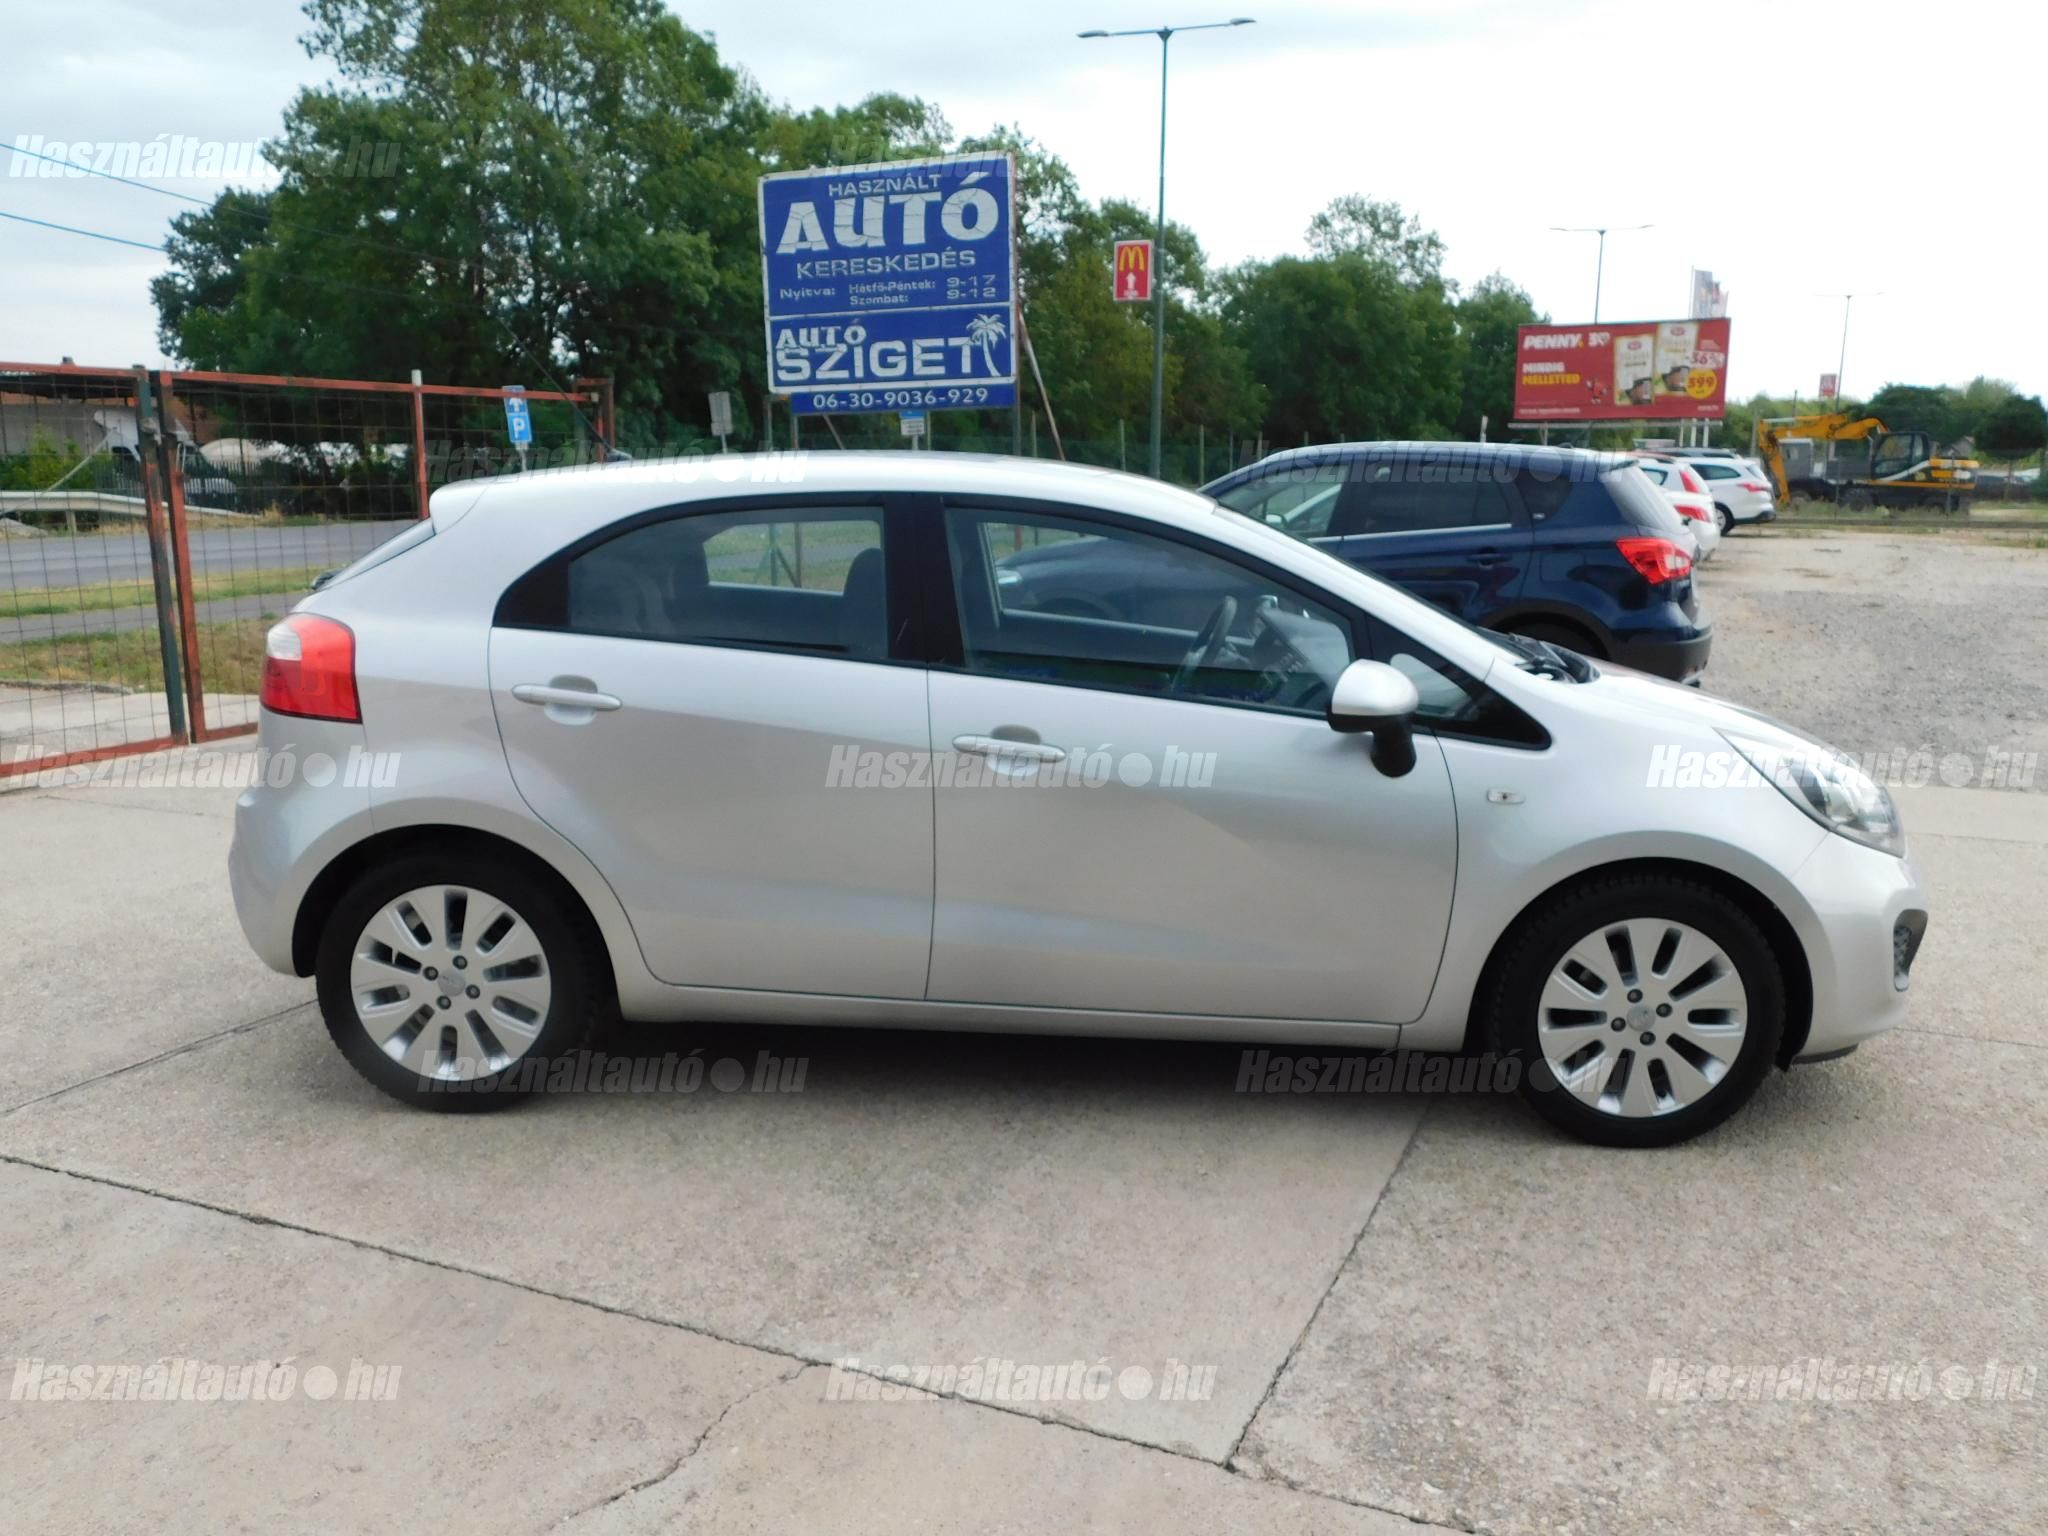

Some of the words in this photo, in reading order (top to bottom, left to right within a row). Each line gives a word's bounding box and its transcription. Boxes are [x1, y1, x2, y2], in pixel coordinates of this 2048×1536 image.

[828, 173, 942, 198] HASZNÁLT
[776, 171, 999, 255] AUTÓ
[796, 247, 976, 280] KERESKEDÉS
[779, 286, 836, 300] Nyitva:
[946, 275, 997, 289] 9-17
[849, 294, 909, 306] Szombat:
[946, 287, 997, 300] 9-12
[776, 318, 867, 350] AUTÓ
[776, 337, 972, 382] SZIGET
[812, 387, 989, 409] 06-30-9036-929
[513, 418, 526, 440] P
